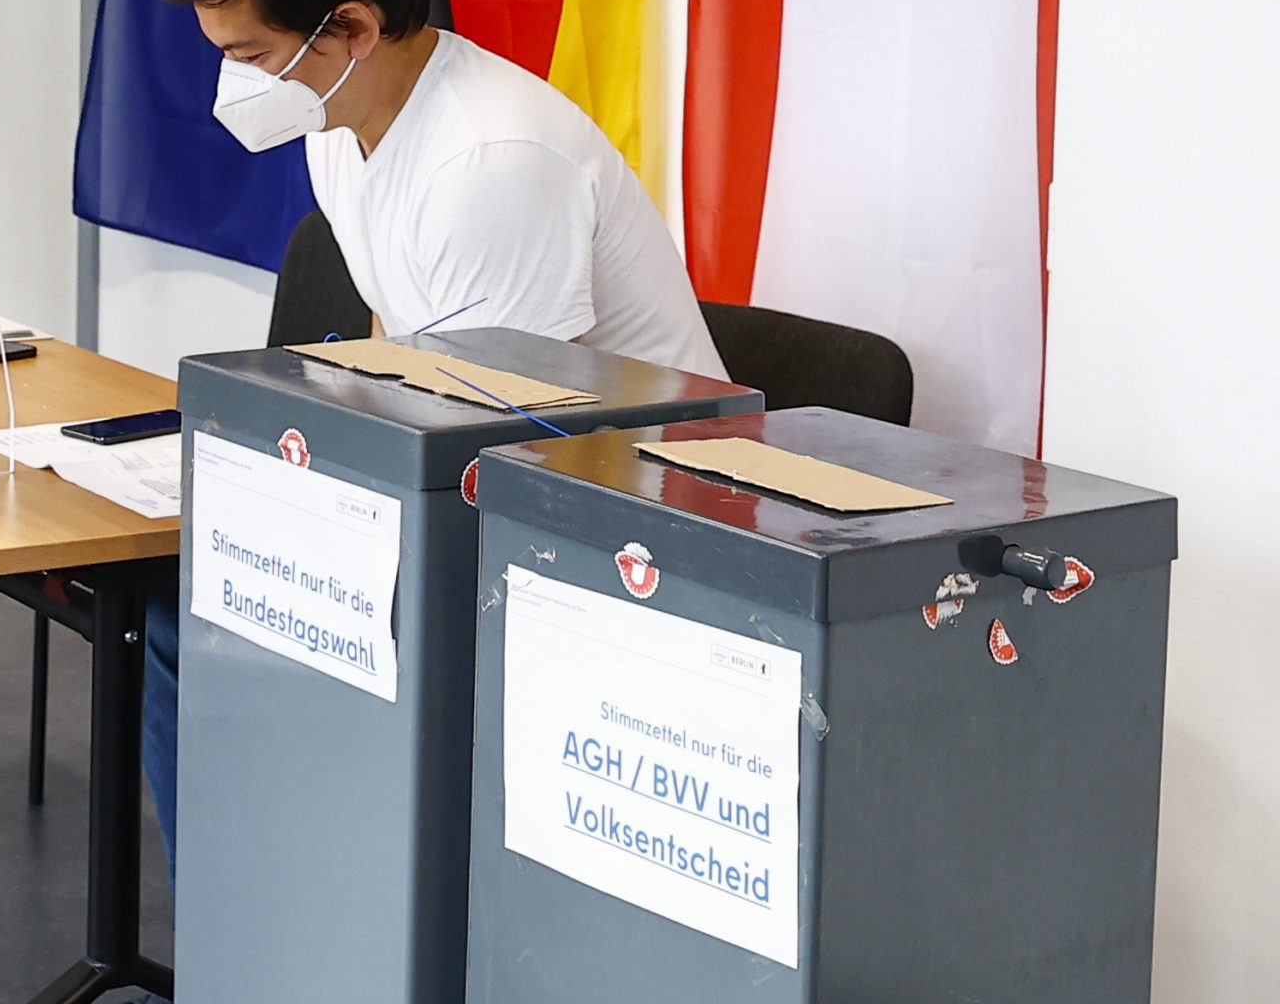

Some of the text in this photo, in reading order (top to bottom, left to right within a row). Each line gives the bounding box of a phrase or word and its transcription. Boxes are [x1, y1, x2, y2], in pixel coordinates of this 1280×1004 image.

[211, 529, 374, 618] Stimmzettel nur für die
[223, 579, 376, 671] Bundestagswahl
[731, 655, 754, 669] BERLIN
[563, 731, 770, 837] AGH / BVV und
[600, 701, 773, 779] Stimmzettel nur für die
[566, 791, 770, 903] Volksentscheid
